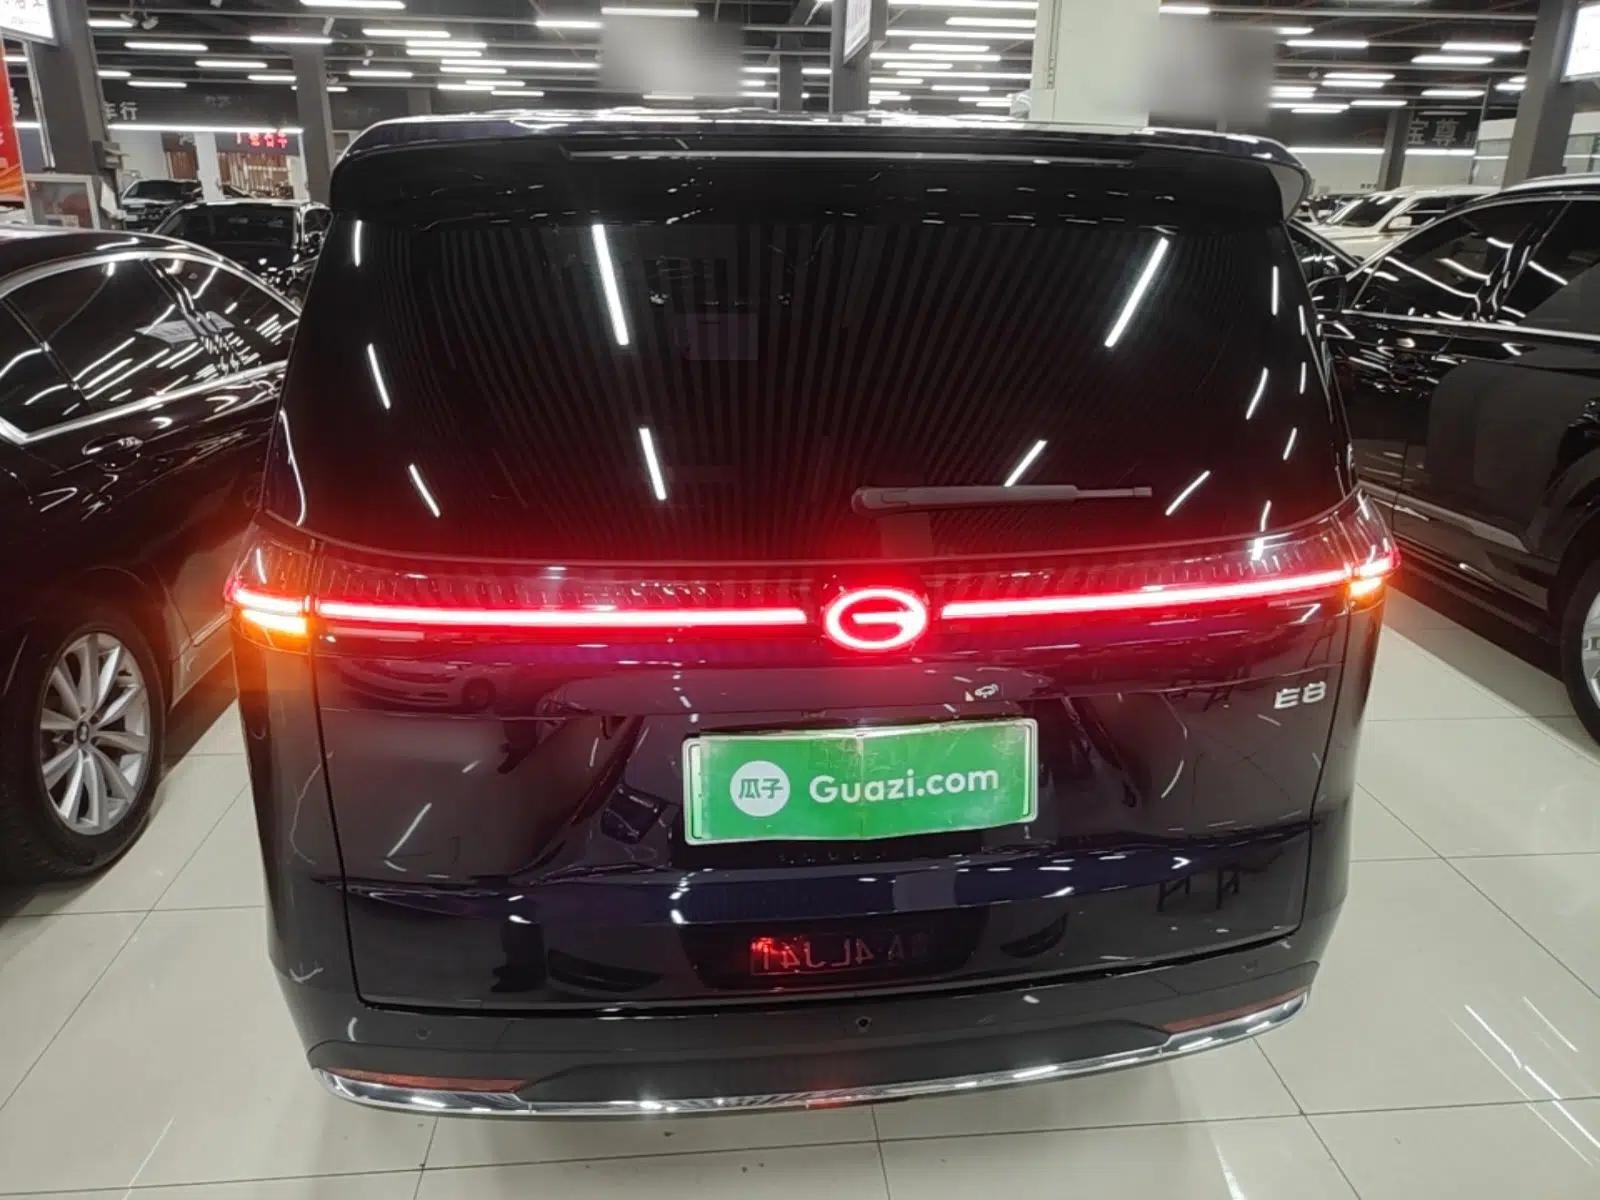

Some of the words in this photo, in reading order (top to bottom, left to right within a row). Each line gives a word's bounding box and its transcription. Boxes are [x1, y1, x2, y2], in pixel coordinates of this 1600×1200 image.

[1274, 681, 1327, 709] E8
[738, 777, 783, 800] 瓜子
[809, 768, 1000, 803] Guazi.com
